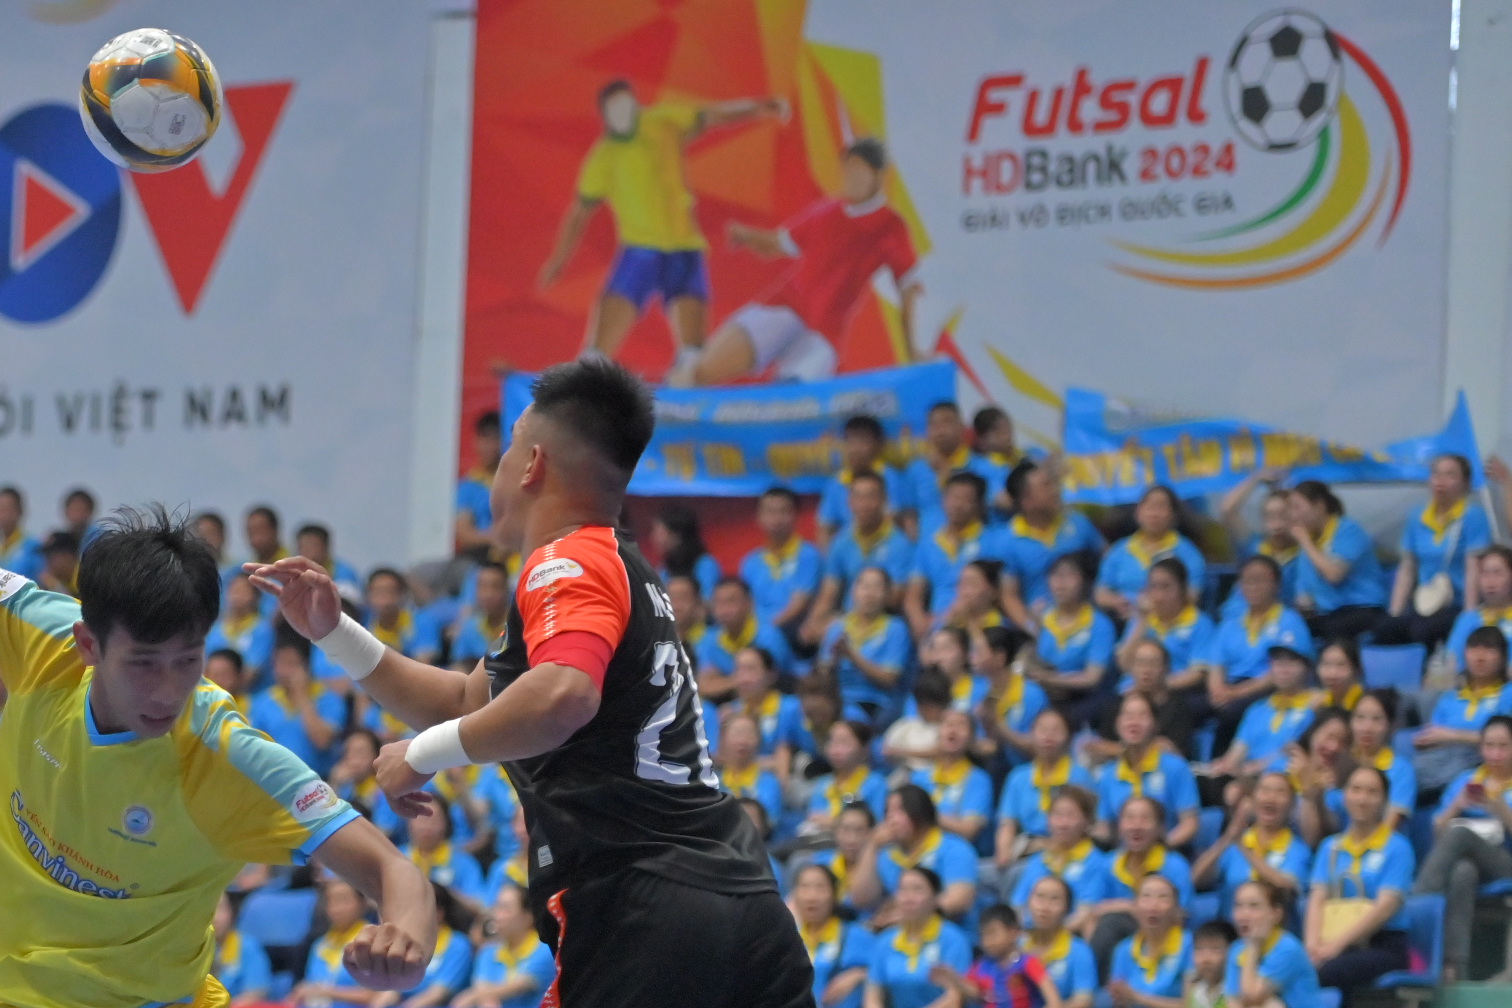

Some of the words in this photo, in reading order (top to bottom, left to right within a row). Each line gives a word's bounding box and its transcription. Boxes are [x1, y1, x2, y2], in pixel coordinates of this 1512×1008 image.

[966, 55, 1210, 142] Futsal
[962, 142, 1129, 197] HDBank
[1138, 140, 1236, 183] 2024
[55, 379, 159, 447] VIỆT
[185, 385, 292, 432] NAM
[528, 564, 566, 587] HDBank
[58, 843, 95, 871] KHÁNH
[96, 866, 120, 883] HÒA
